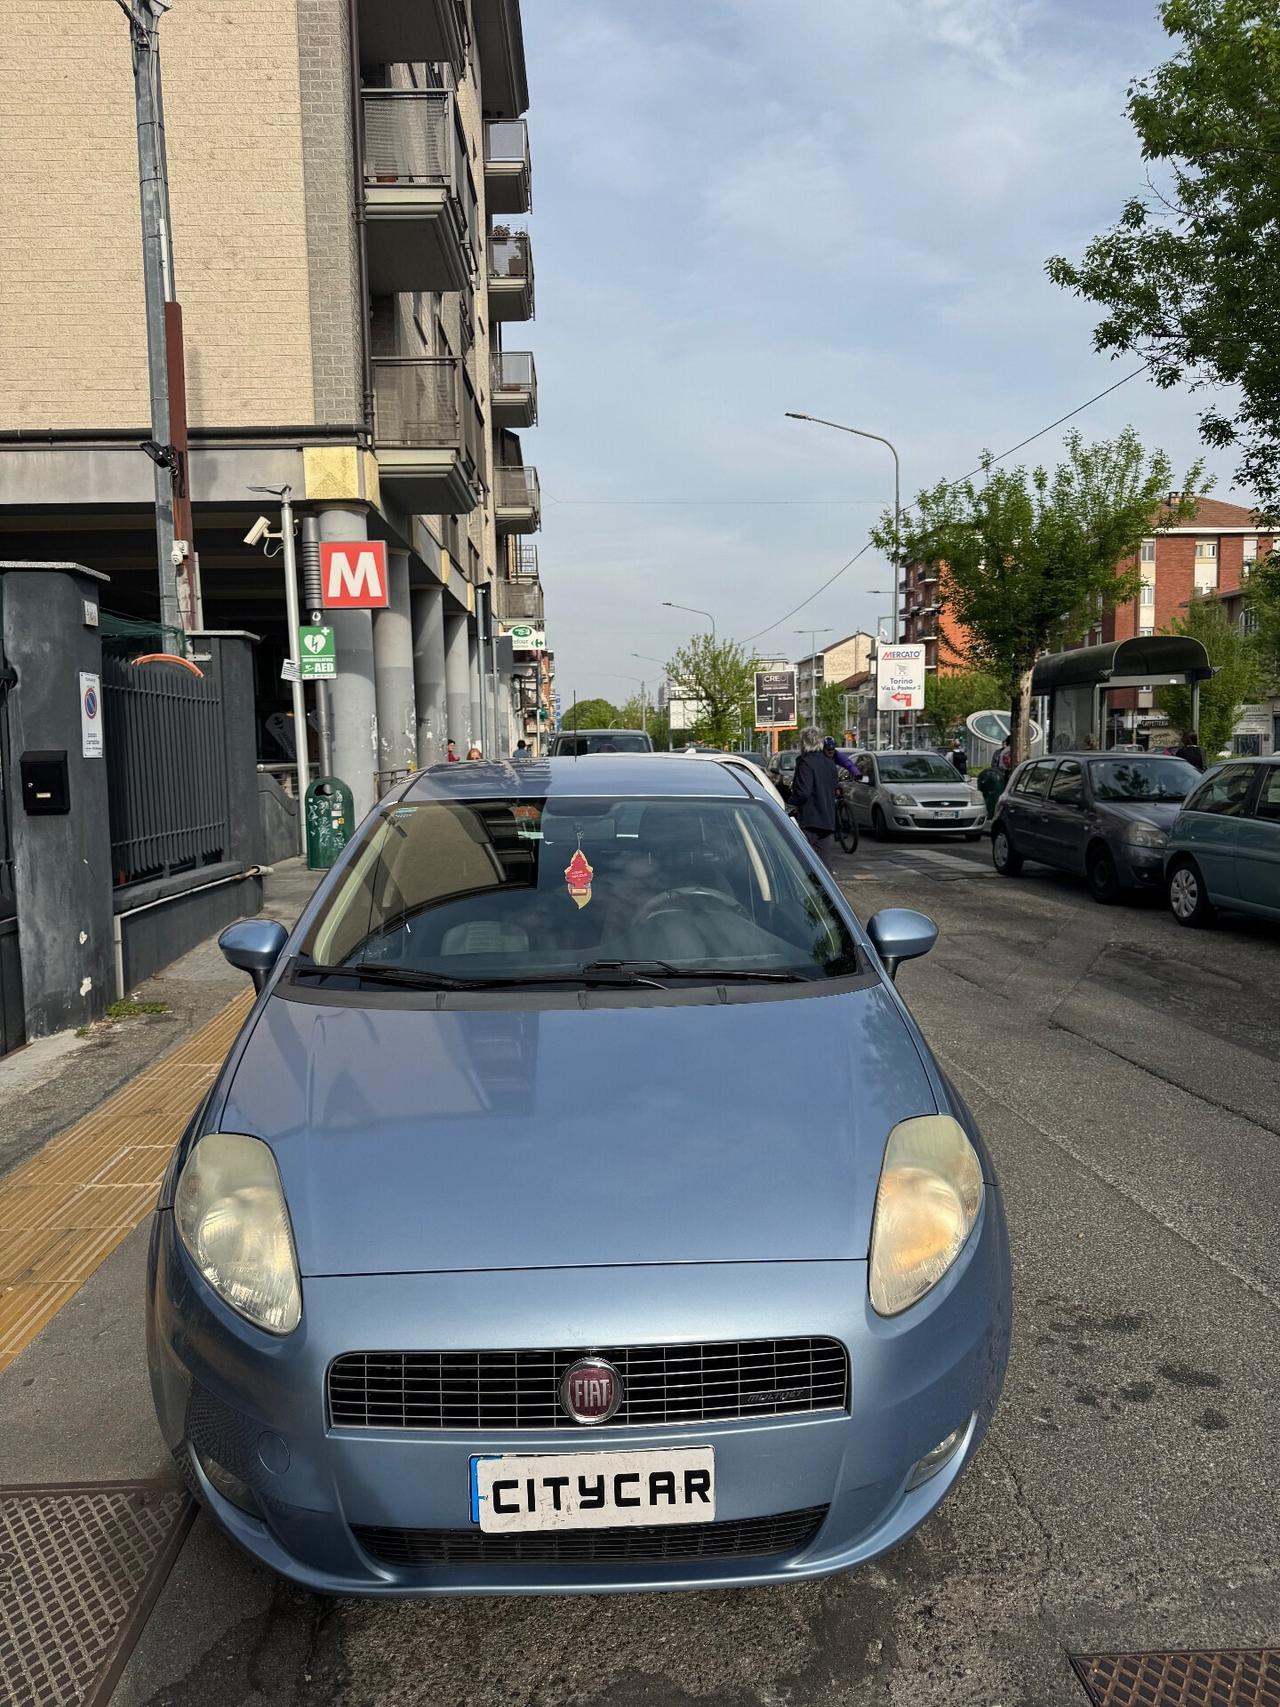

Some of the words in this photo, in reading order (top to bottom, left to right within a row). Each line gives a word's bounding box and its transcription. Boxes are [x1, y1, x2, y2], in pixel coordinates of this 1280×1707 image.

[328, 552, 382, 597] M
[315, 663, 334, 672] AED
[575, 1379, 609, 1407] FIAT
[748, 1390, 804, 1402] MULTIJET
[492, 1469, 711, 1514] CITYCAR
